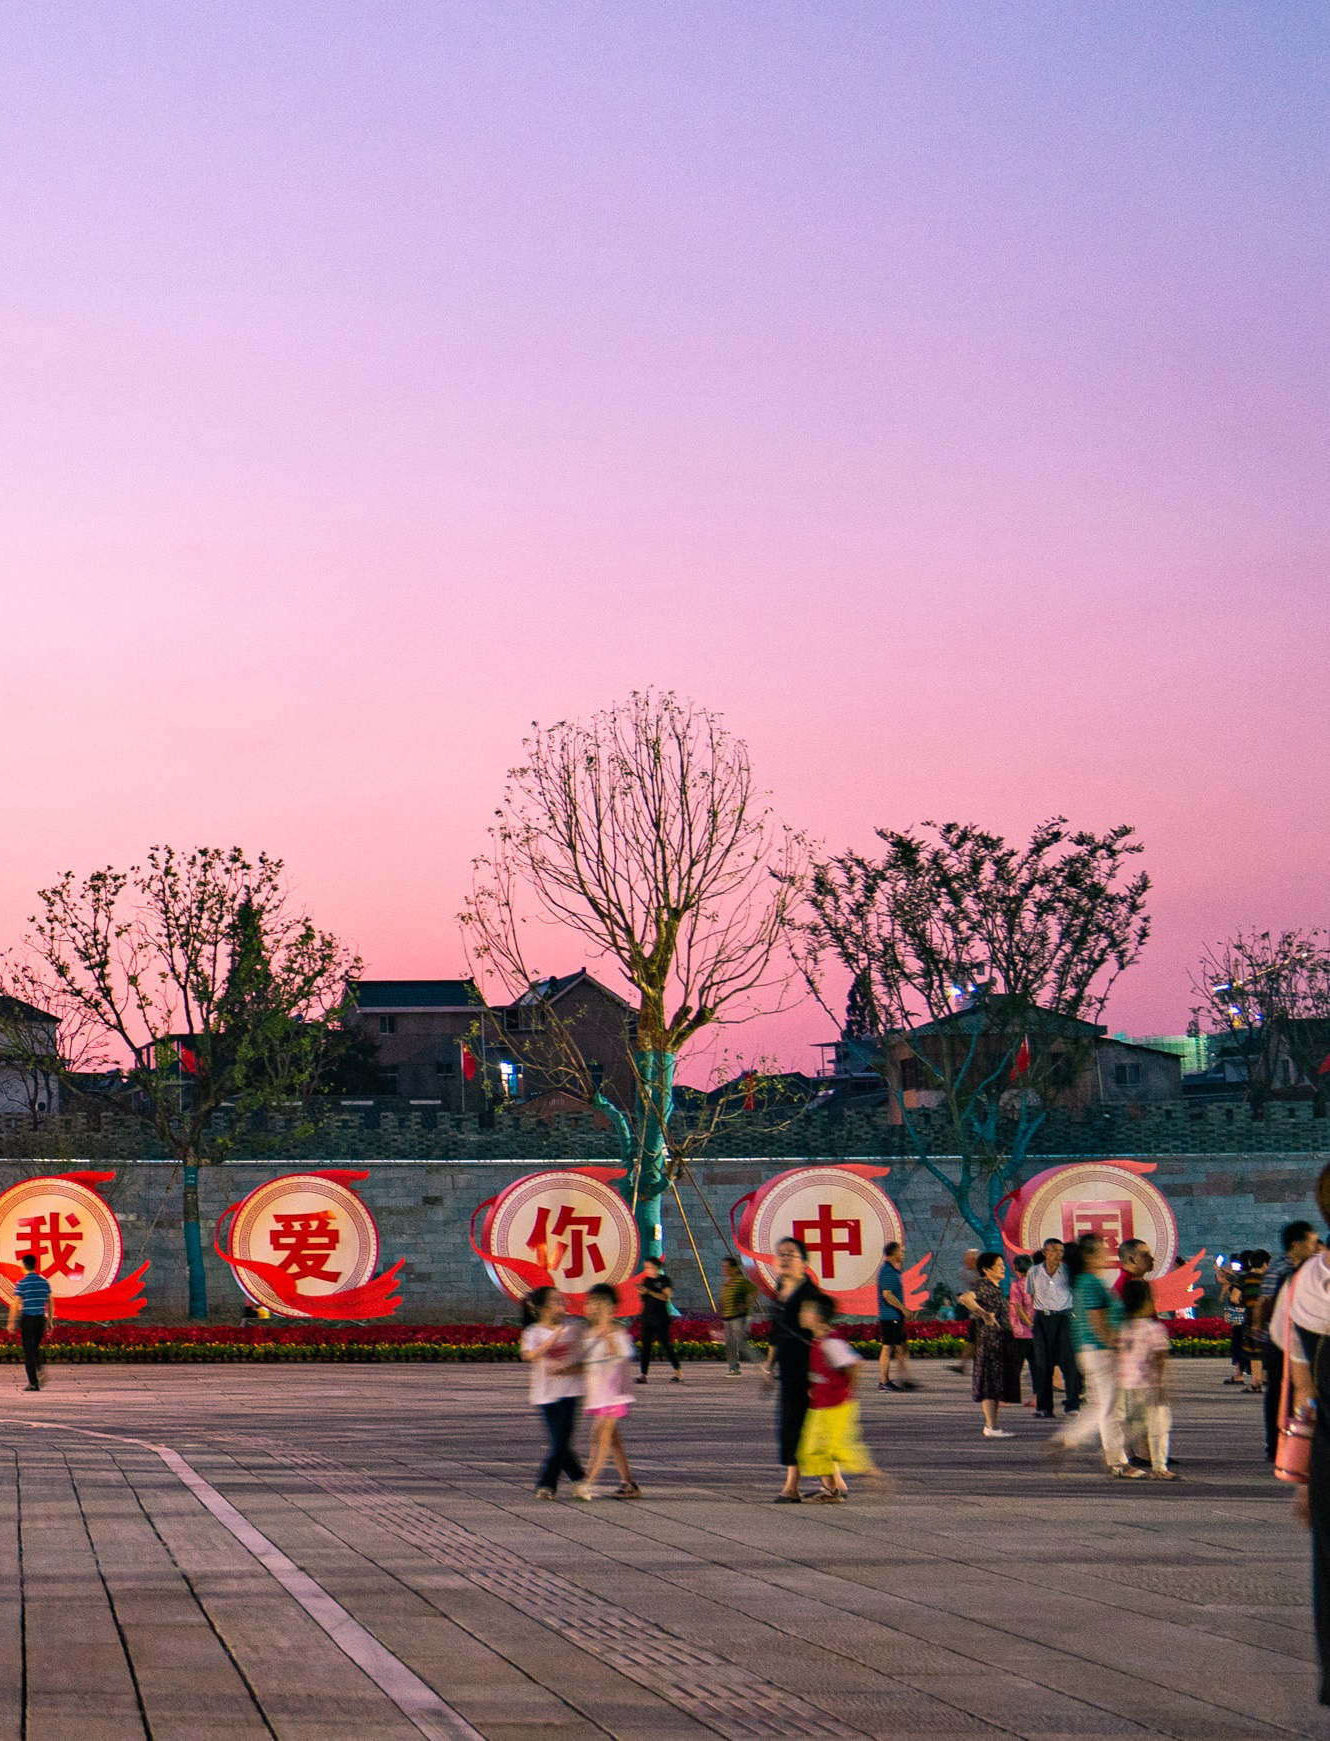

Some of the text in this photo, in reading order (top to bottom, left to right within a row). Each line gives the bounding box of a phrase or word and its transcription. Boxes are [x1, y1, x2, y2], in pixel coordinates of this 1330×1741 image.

[15, 1212, 85, 1280] 我
[270, 1210, 342, 1283] 爱
[526, 1205, 606, 1278] 你
[792, 1204, 862, 1278] 中
